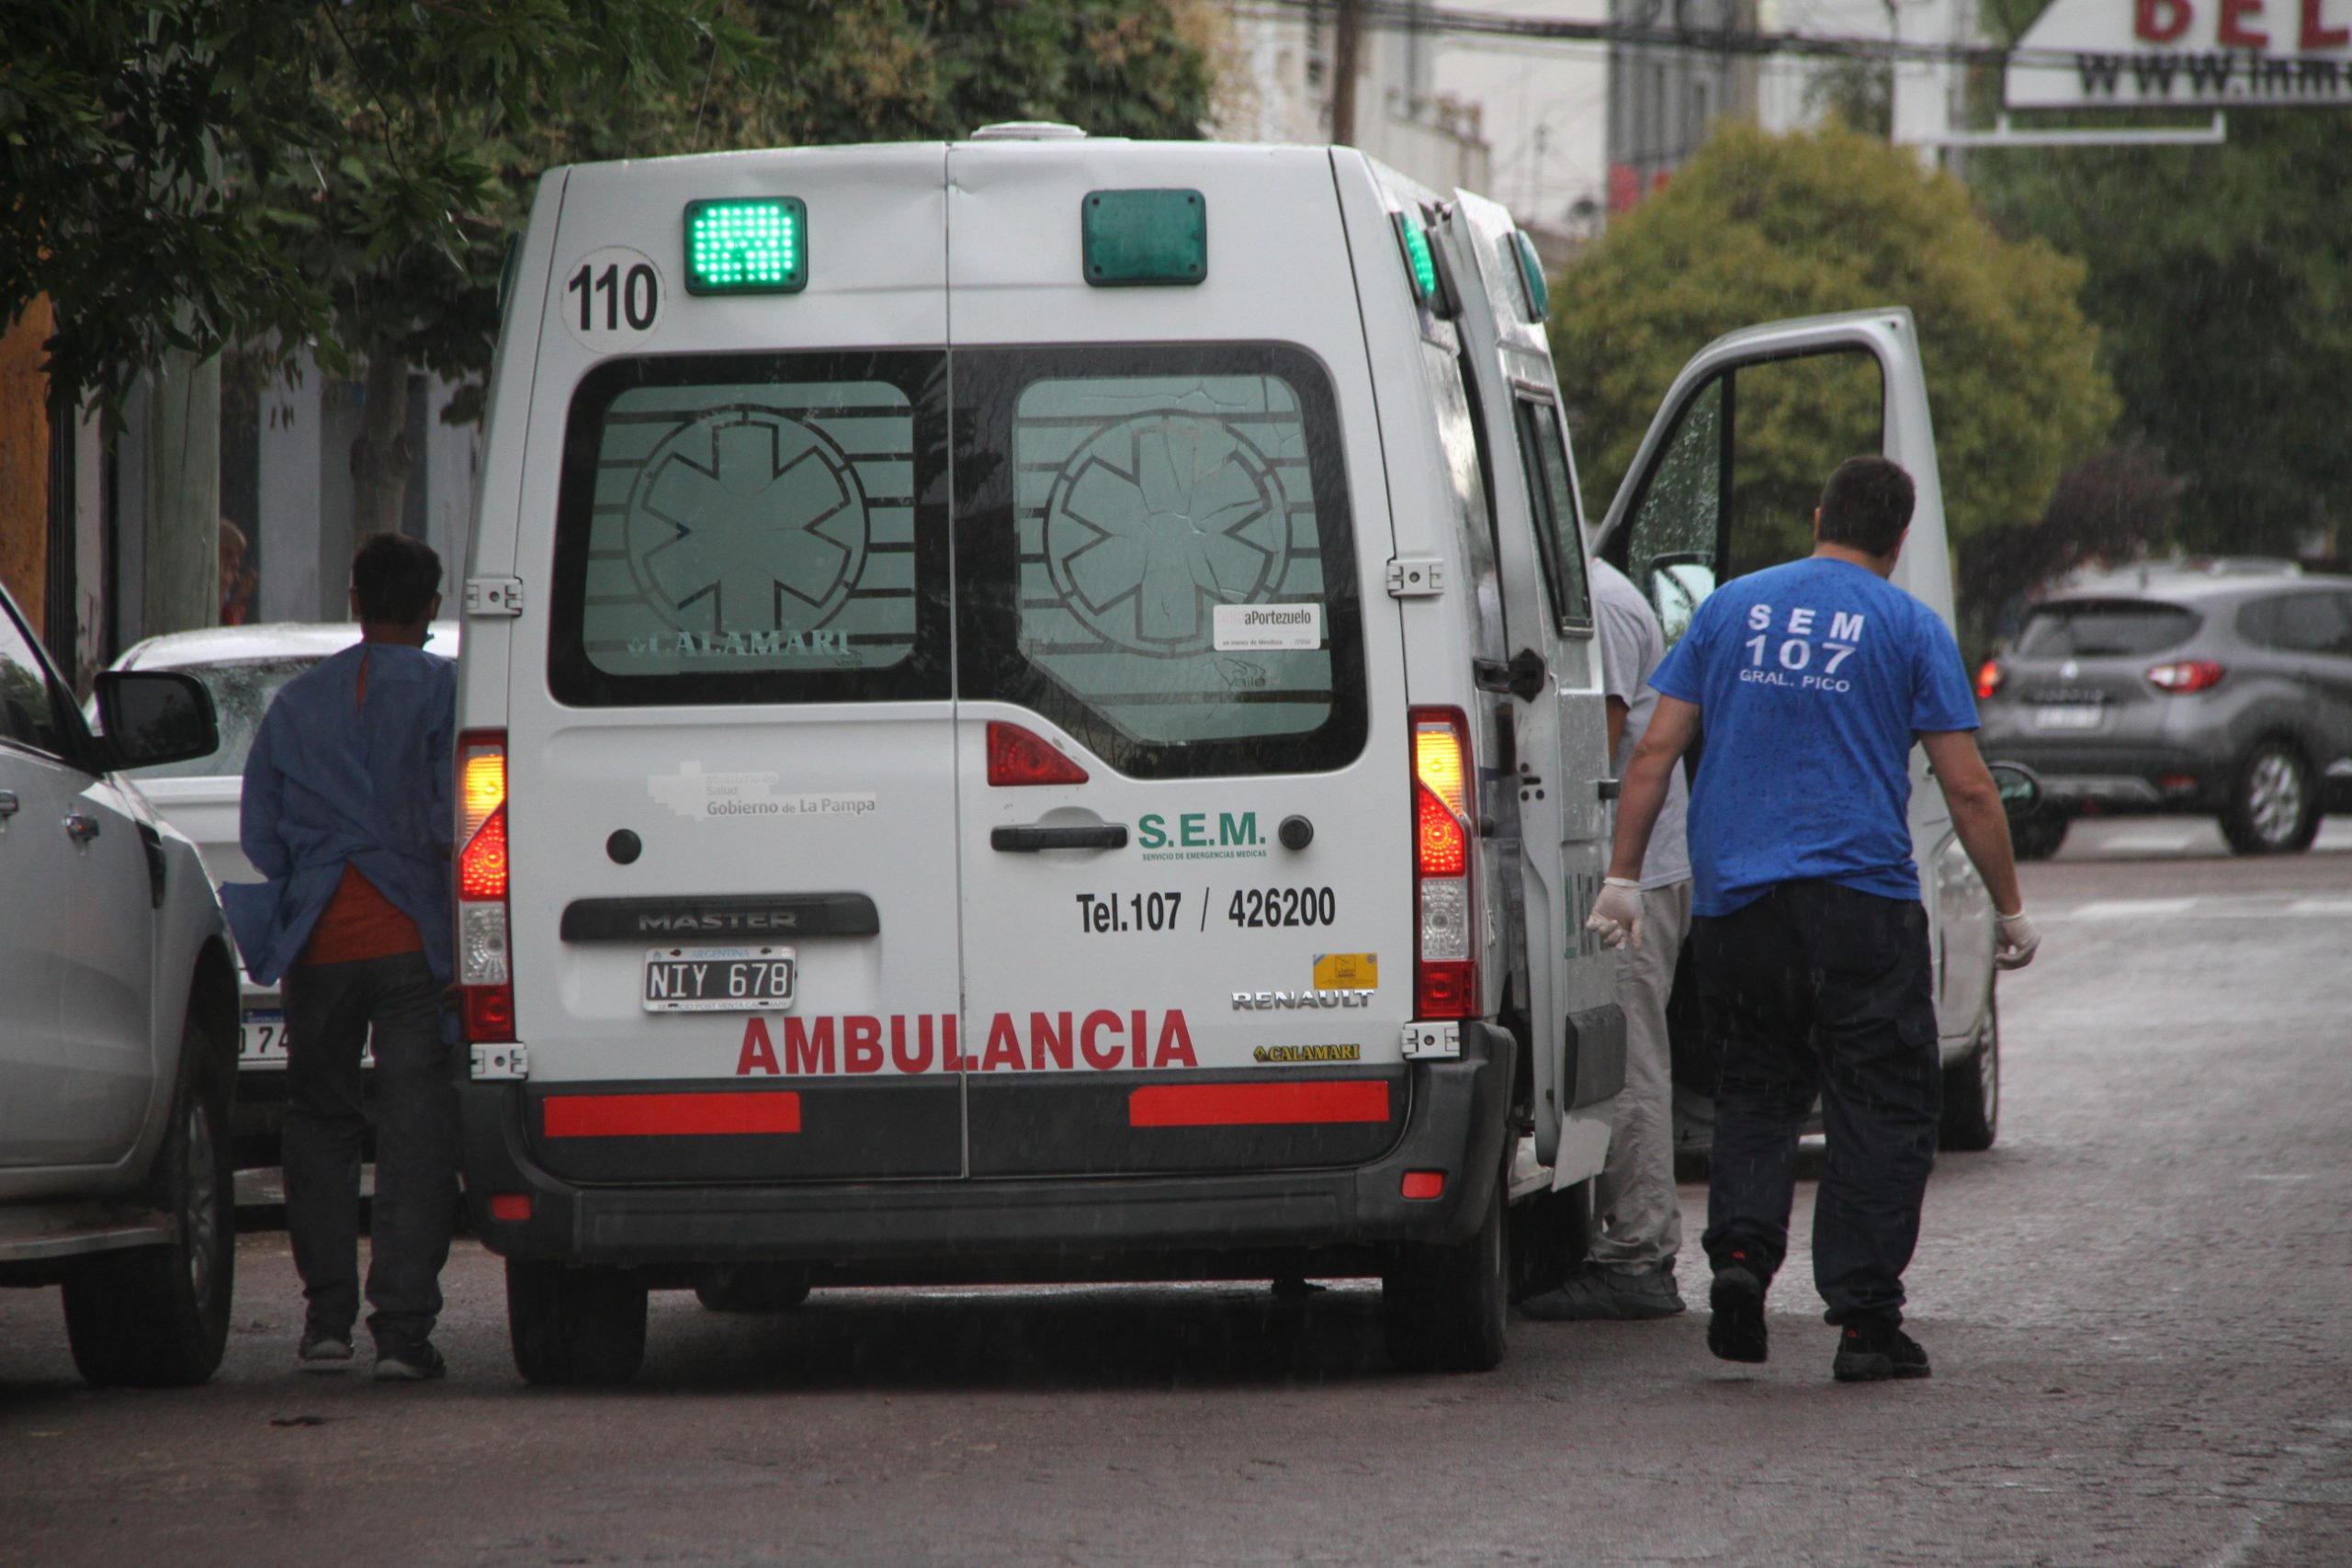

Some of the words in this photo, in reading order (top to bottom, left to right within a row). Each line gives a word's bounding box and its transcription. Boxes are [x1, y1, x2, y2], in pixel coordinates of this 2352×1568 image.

[2075, 50, 2352, 96] www.inm
[569, 263, 658, 331] 110
[1747, 604, 1865, 642] SEM
[1746, 634, 1856, 675] 107
[1739, 669, 1794, 687] GRAL.
[1802, 675, 1850, 693] PICO
[706, 785, 738, 796] Salud
[706, 799, 779, 816] Gobierno
[782, 803, 797, 814] de
[799, 798, 818, 813] La
[821, 797, 876, 815] Pampa
[1137, 811, 1266, 849] S.E.M.
[1142, 852, 1174, 861] SERVICIO
[1175, 852, 1184, 860] DE
[1186, 850, 1235, 860] EMERGENCIAS
[1236, 849, 1267, 858] MEDICAS
[639, 911, 797, 931] MASTER
[1075, 892, 1182, 933] Tel.107
[1201, 886, 1209, 931] /
[1228, 886, 1336, 929] 426200
[690, 948, 751, 959] ARGENTINA
[650, 963, 709, 998] NIY
[729, 962, 788, 998] 678
[1231, 989, 1375, 1010] RENAULT
[736, 1009, 1199, 1076] AMBULANCIA
[1267, 1043, 1361, 1061] CALAMARI
